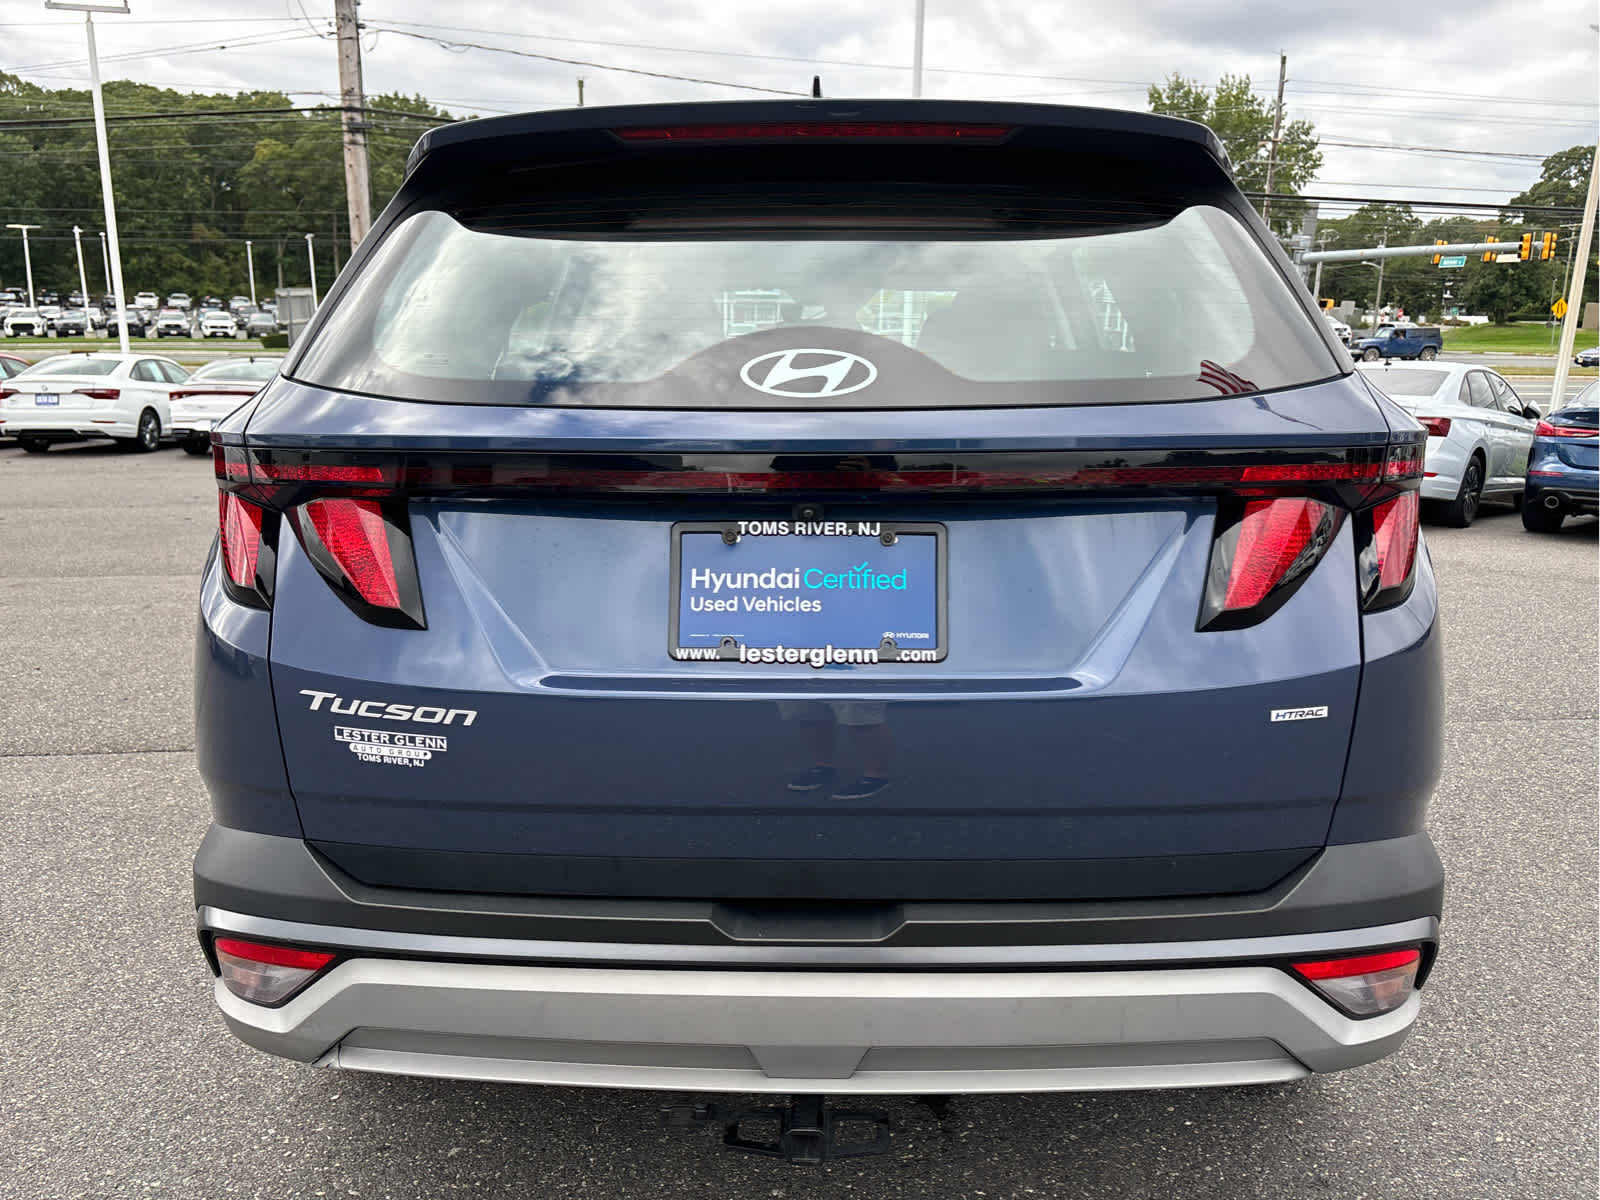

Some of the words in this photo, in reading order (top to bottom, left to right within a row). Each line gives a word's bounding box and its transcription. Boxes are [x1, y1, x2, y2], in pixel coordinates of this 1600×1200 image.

[738, 521, 789, 536] TOMS
[795, 521, 853, 537] RIVER,
[858, 521, 881, 536] NJ
[690, 567, 800, 594] Hyundai
[803, 561, 908, 590] Certified
[690, 596, 738, 612] Used
[742, 596, 822, 612] Vehicles
[675, 648, 720, 660] www.
[740, 644, 878, 667] lesterglenn
[896, 650, 937, 661] .com
[1274, 707, 1325, 720] HTRAC
[334, 728, 390, 745] LESTER
[394, 735, 448, 750] GLENN
[352, 744, 382, 754] AUTO
[389, 748, 429, 759] GROUP
[357, 753, 381, 763] TOMS
[413, 759, 425, 768] NJ
